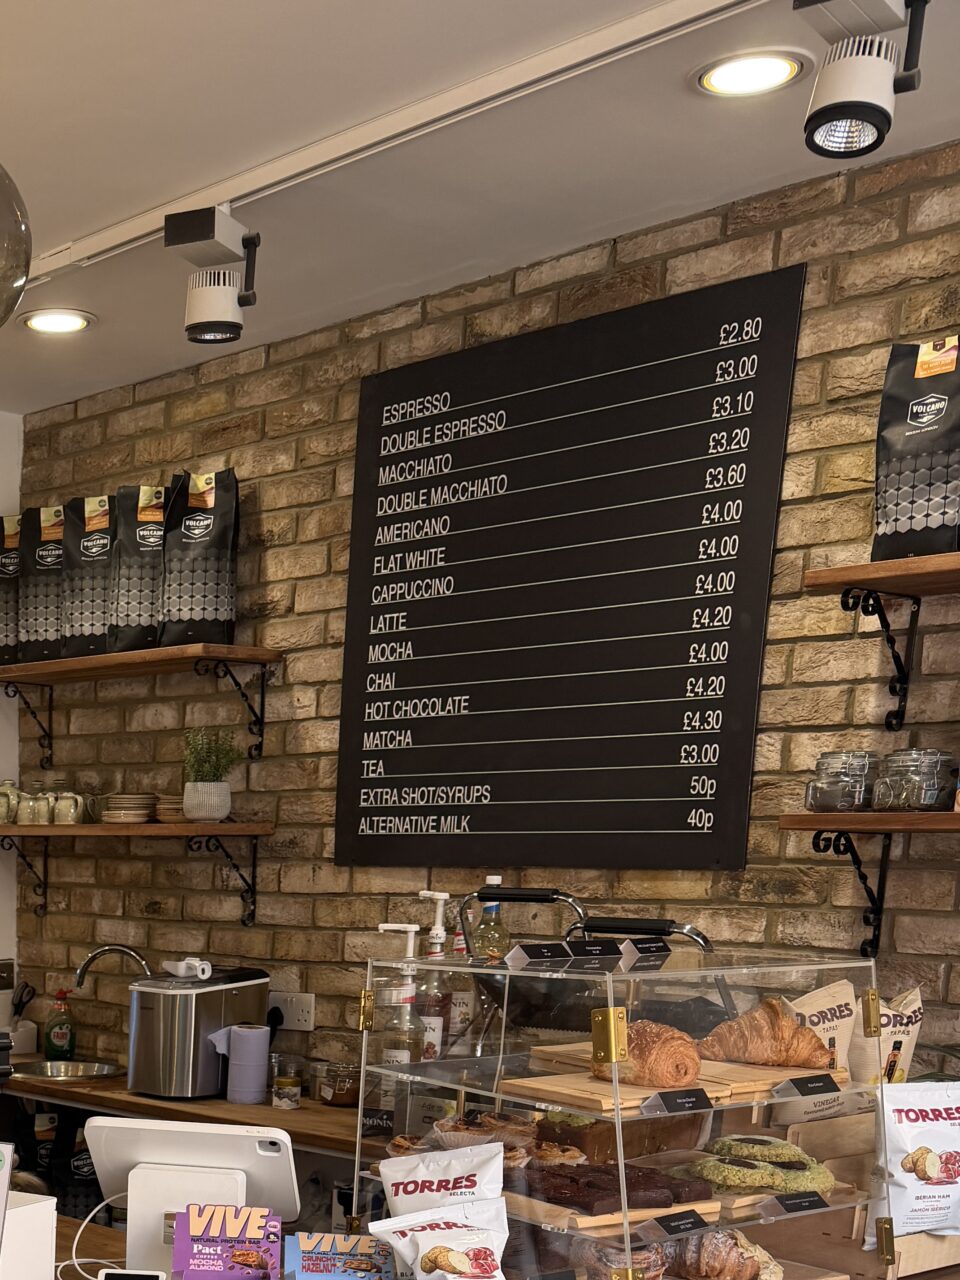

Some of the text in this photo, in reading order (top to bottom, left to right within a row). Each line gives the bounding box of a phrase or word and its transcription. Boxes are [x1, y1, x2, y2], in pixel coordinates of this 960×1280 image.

[382, 317, 763, 425] ESPRESSO £2.80
[380, 354, 758, 454] DOUBLE ESPRESSO £3.00
[912, 401, 946, 413] VOLCANO
[378, 390, 754, 485] MACCHIATO £3.10
[377, 427, 750, 515] DOUBLE MACCHIATO £3.20
[374, 463, 746, 545] AMERICANO £3.60
[373, 499, 743, 575] FLAT WHITE £4.00
[372, 535, 739, 604] CAPPUCCINO £4.00
[370, 571, 735, 633] LATTE £4.00
[368, 605, 732, 663] MOCHA £4.20
[367, 641, 729, 692] CHAI £4.00
[365, 675, 725, 721] HOT CHOCOLATE £4.20
[363, 710, 722, 749] MATCHA £4.30
[362, 744, 719, 777] TEA £3.00
[360, 776, 716, 806] EXTRA SHOT/SYRUPS 50p
[358, 808, 714, 834] ALTERNATIVE MILK 40p
[391, 1173, 478, 1198] TORRES
[189, 1204, 270, 1239] VIVE
[298, 1232, 378, 1254] VIVE
[192, 1244, 222, 1254] Pact
[301, 1263, 337, 1273] HAZELNUT
